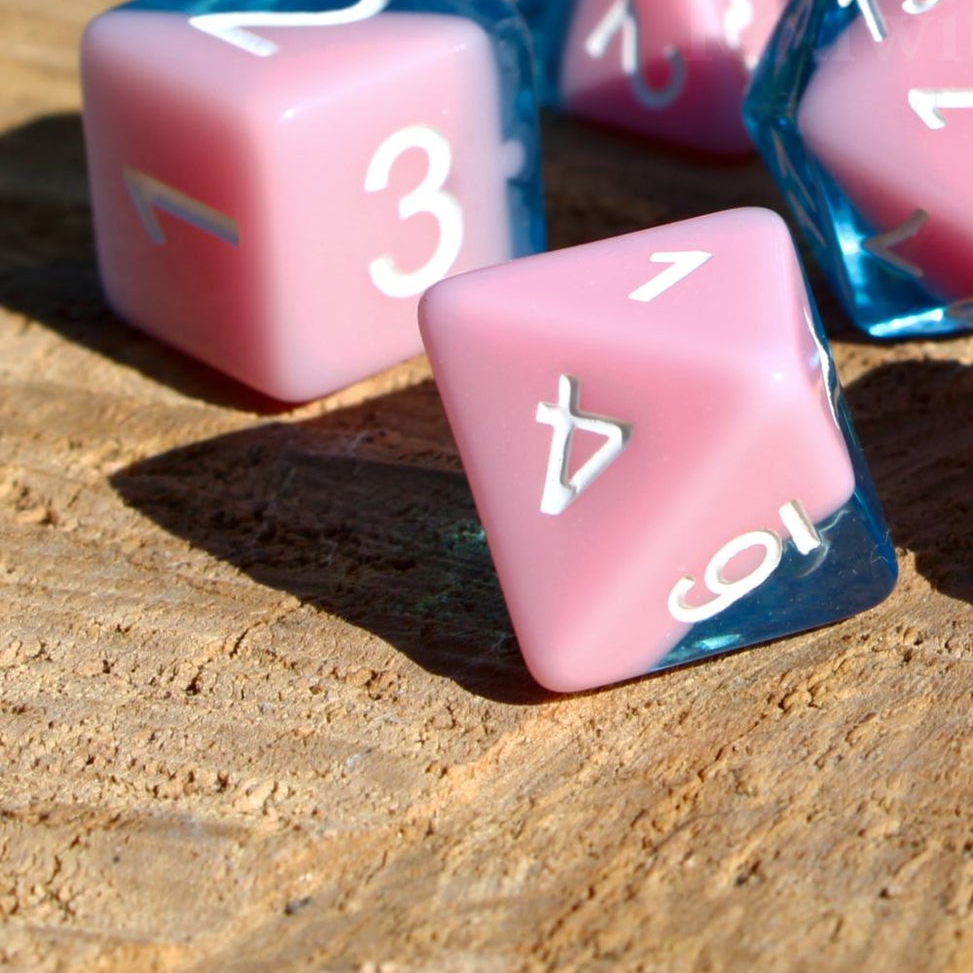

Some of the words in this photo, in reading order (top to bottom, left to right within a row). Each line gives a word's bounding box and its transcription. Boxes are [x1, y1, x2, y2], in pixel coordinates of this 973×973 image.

[123, 164, 240, 247] 1
[364, 125, 464, 298] 3
[627, 249, 713, 303] 1
[535, 374, 635, 516] 4
